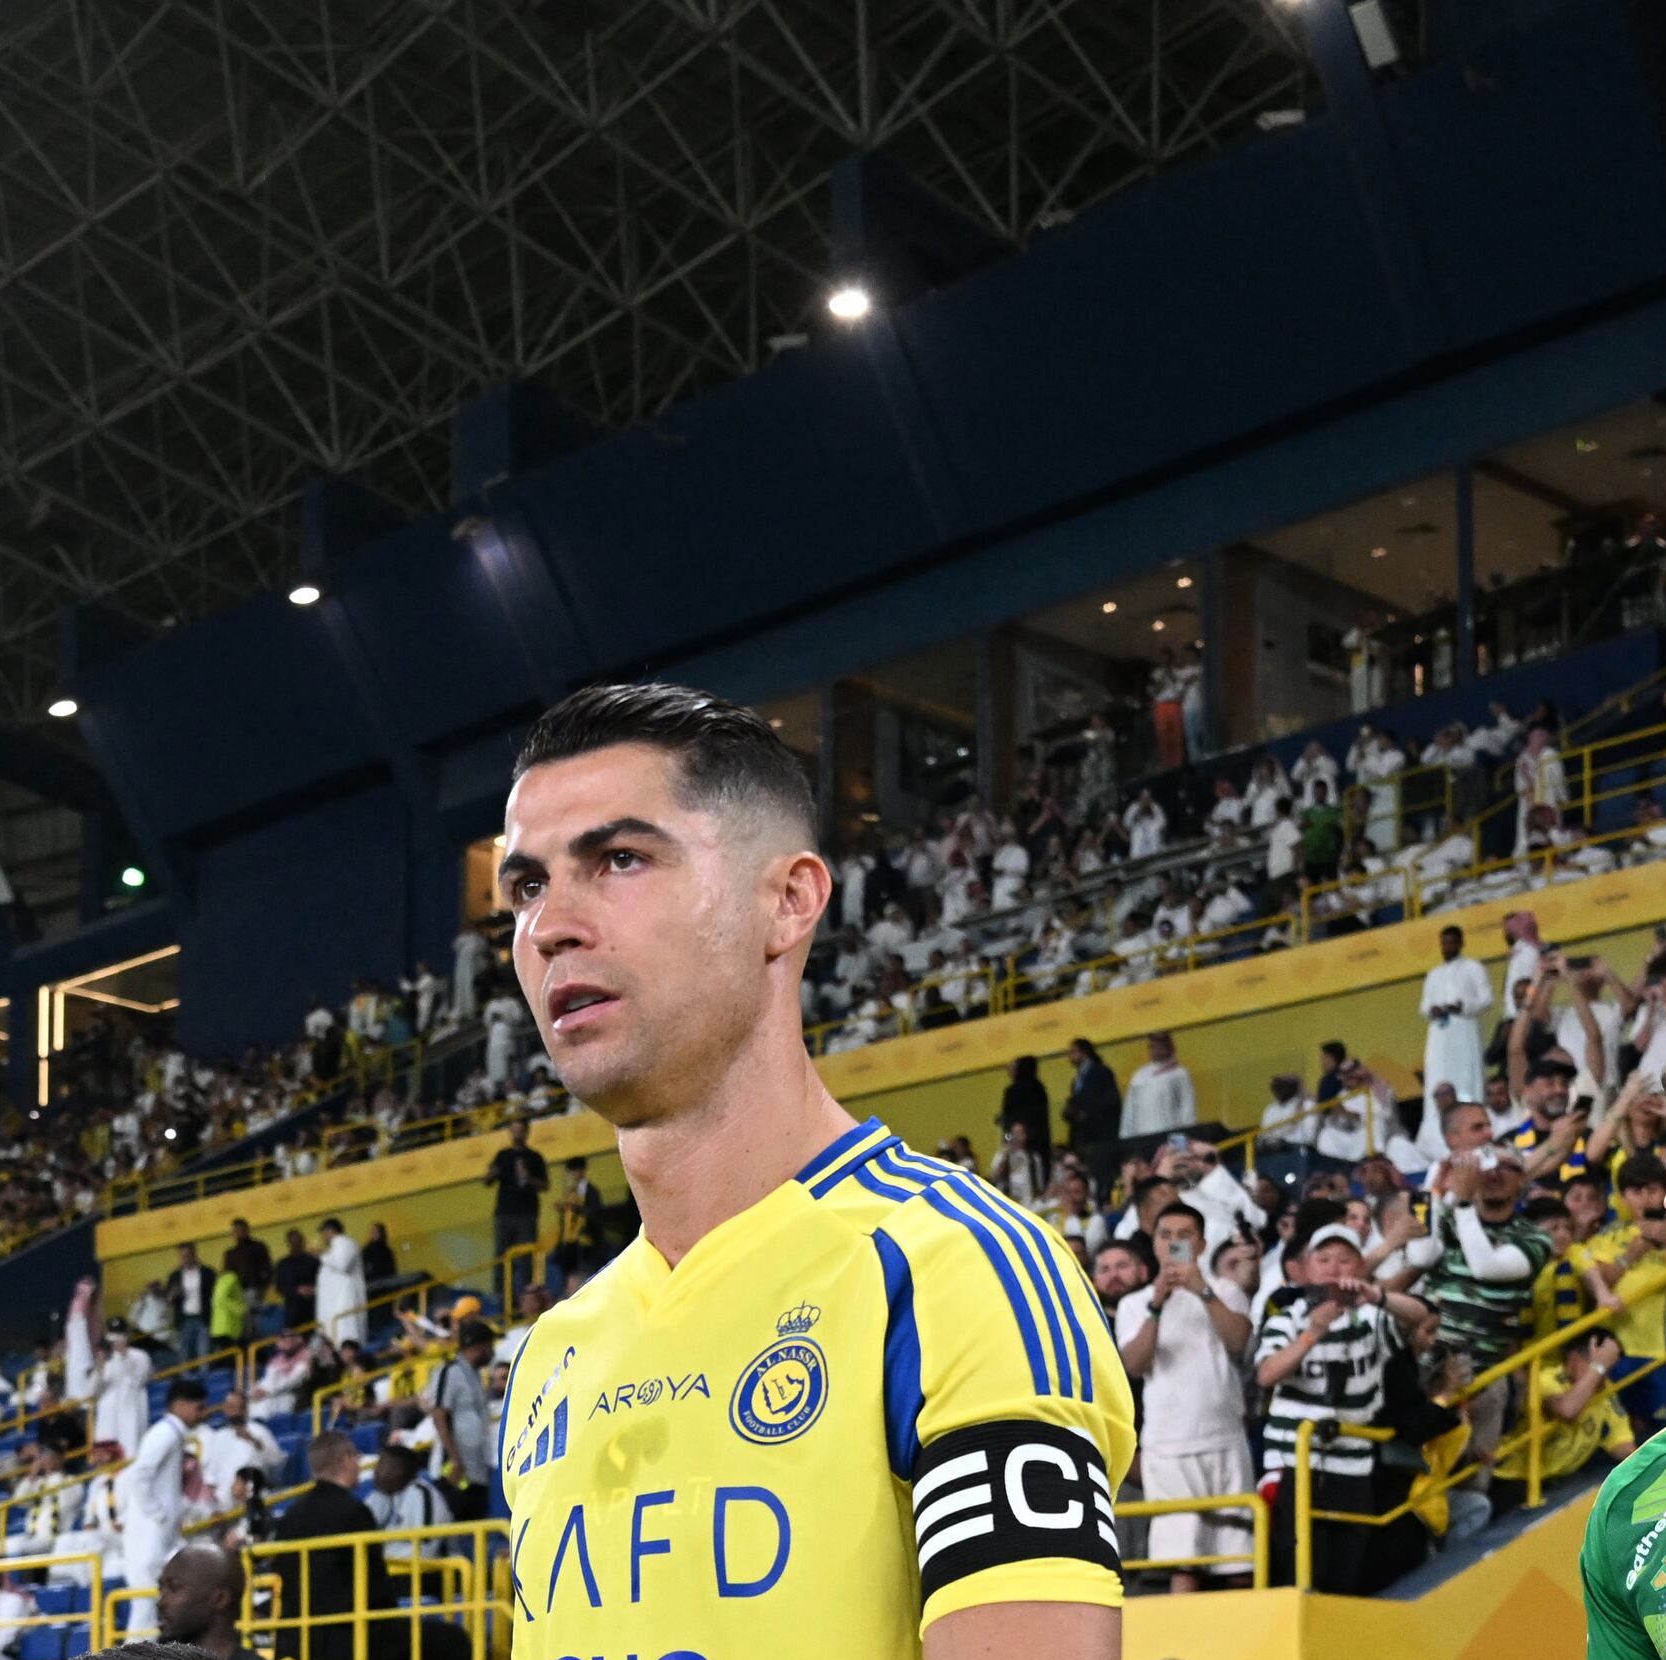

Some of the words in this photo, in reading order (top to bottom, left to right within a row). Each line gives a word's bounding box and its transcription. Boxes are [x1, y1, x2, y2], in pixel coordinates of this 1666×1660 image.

[778, 1349, 817, 1373] NASSR
[743, 1410, 785, 1436] FOOTBALL
[787, 1406, 811, 1431] CLUB
[1005, 1442, 1080, 1530] C
